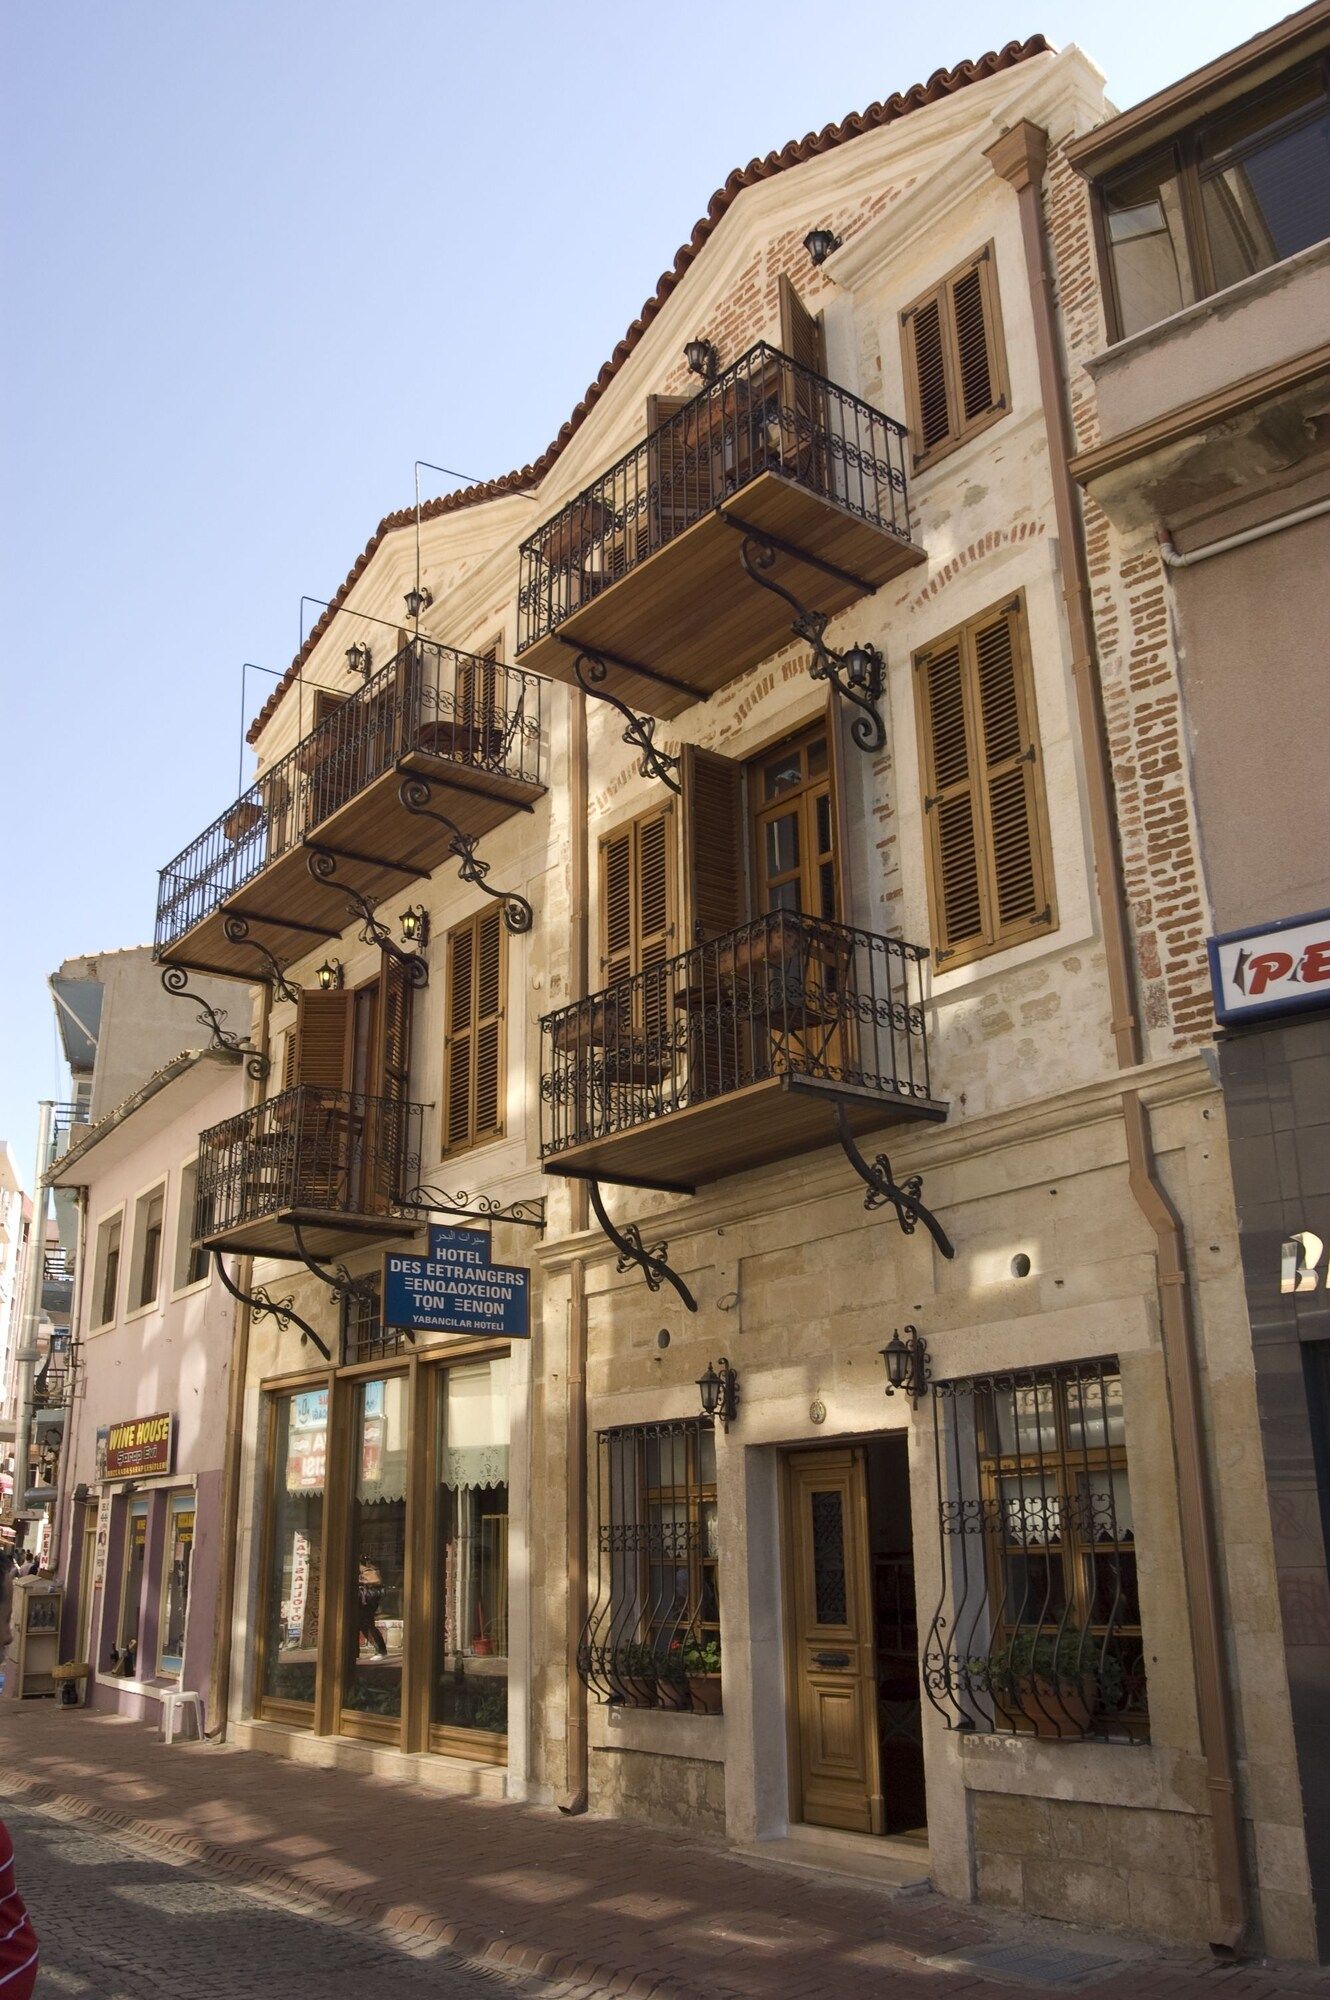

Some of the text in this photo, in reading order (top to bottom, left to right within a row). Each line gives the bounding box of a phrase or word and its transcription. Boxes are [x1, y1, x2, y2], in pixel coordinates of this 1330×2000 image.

[436, 1247, 483, 1265] HOTEL
[390, 1259, 524, 1286] DES EETRANGERS
[412, 1315, 504, 1331] YABANCILAR HOTELİ
[109, 1418, 169, 1450] WINE HOUSE
[143, 1444, 157, 1460] Evi
